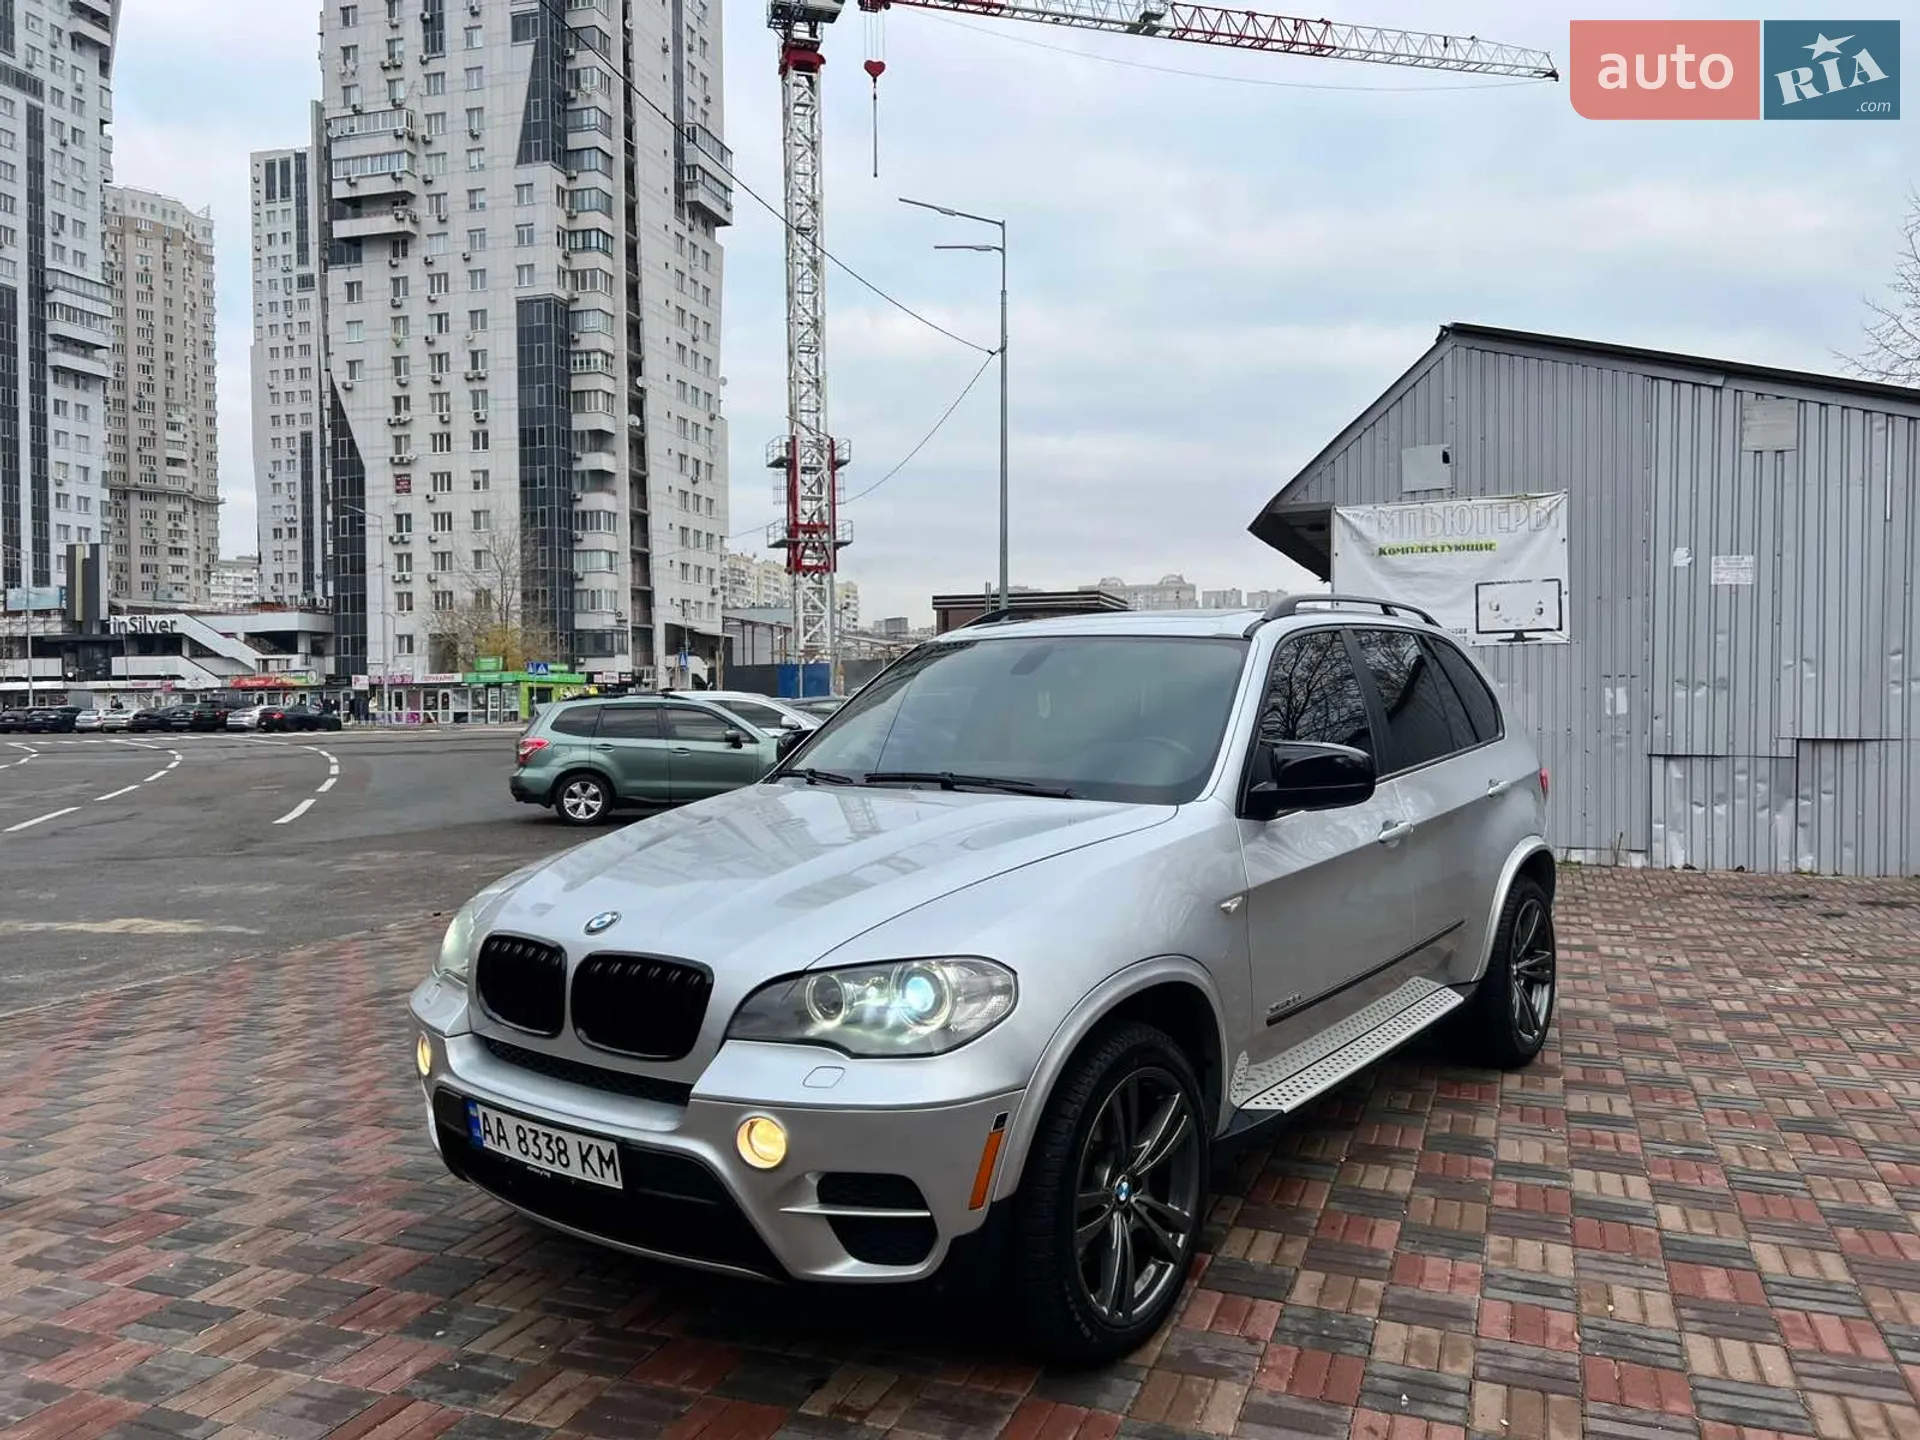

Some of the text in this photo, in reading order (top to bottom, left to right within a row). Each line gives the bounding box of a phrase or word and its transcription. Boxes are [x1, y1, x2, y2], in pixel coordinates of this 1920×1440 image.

[481, 1111, 619, 1182] AA 8338 KM
